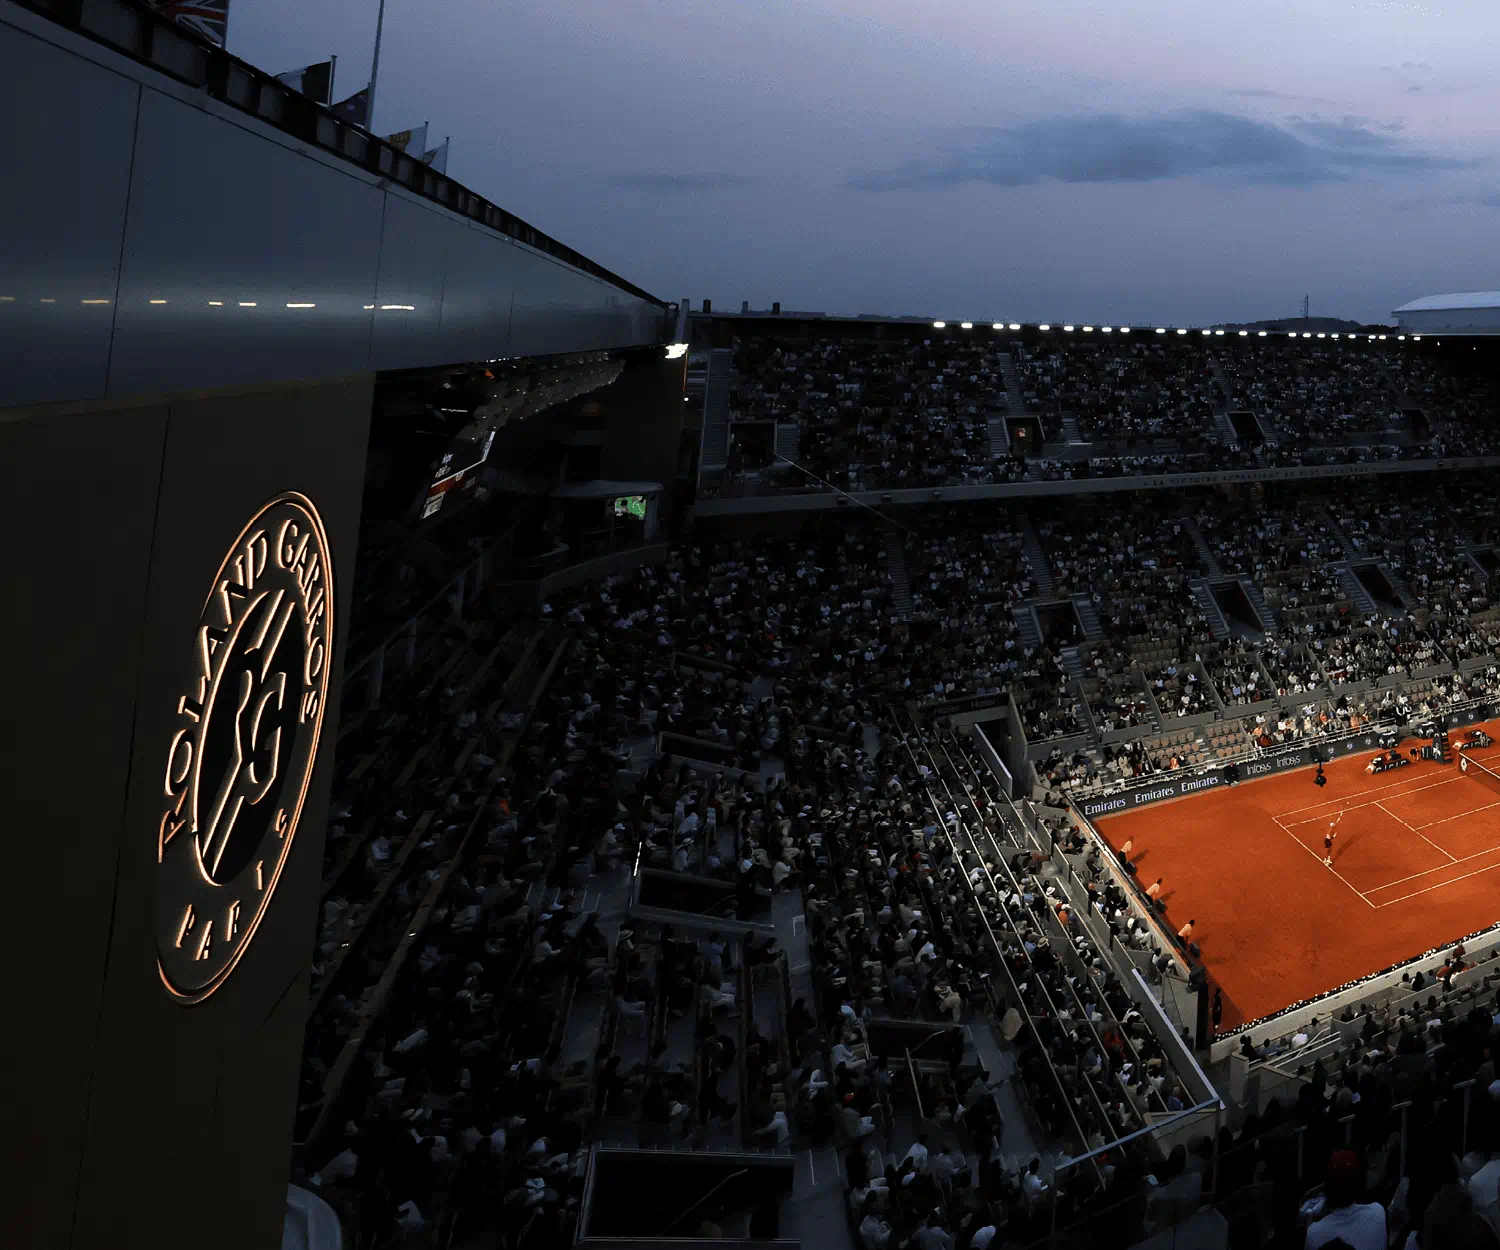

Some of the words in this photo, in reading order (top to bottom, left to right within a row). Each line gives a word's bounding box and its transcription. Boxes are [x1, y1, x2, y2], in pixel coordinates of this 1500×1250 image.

[157, 528, 269, 863] ROLAND
[277, 518, 325, 724] GARROS
[1084, 798, 1126, 816] Emirates
[1135, 786, 1175, 804] Emirates
[1181, 775, 1219, 793] Emirates
[1246, 761, 1272, 776] Infosys
[1276, 754, 1301, 768] Infosys
[174, 807, 288, 961] PARIS
